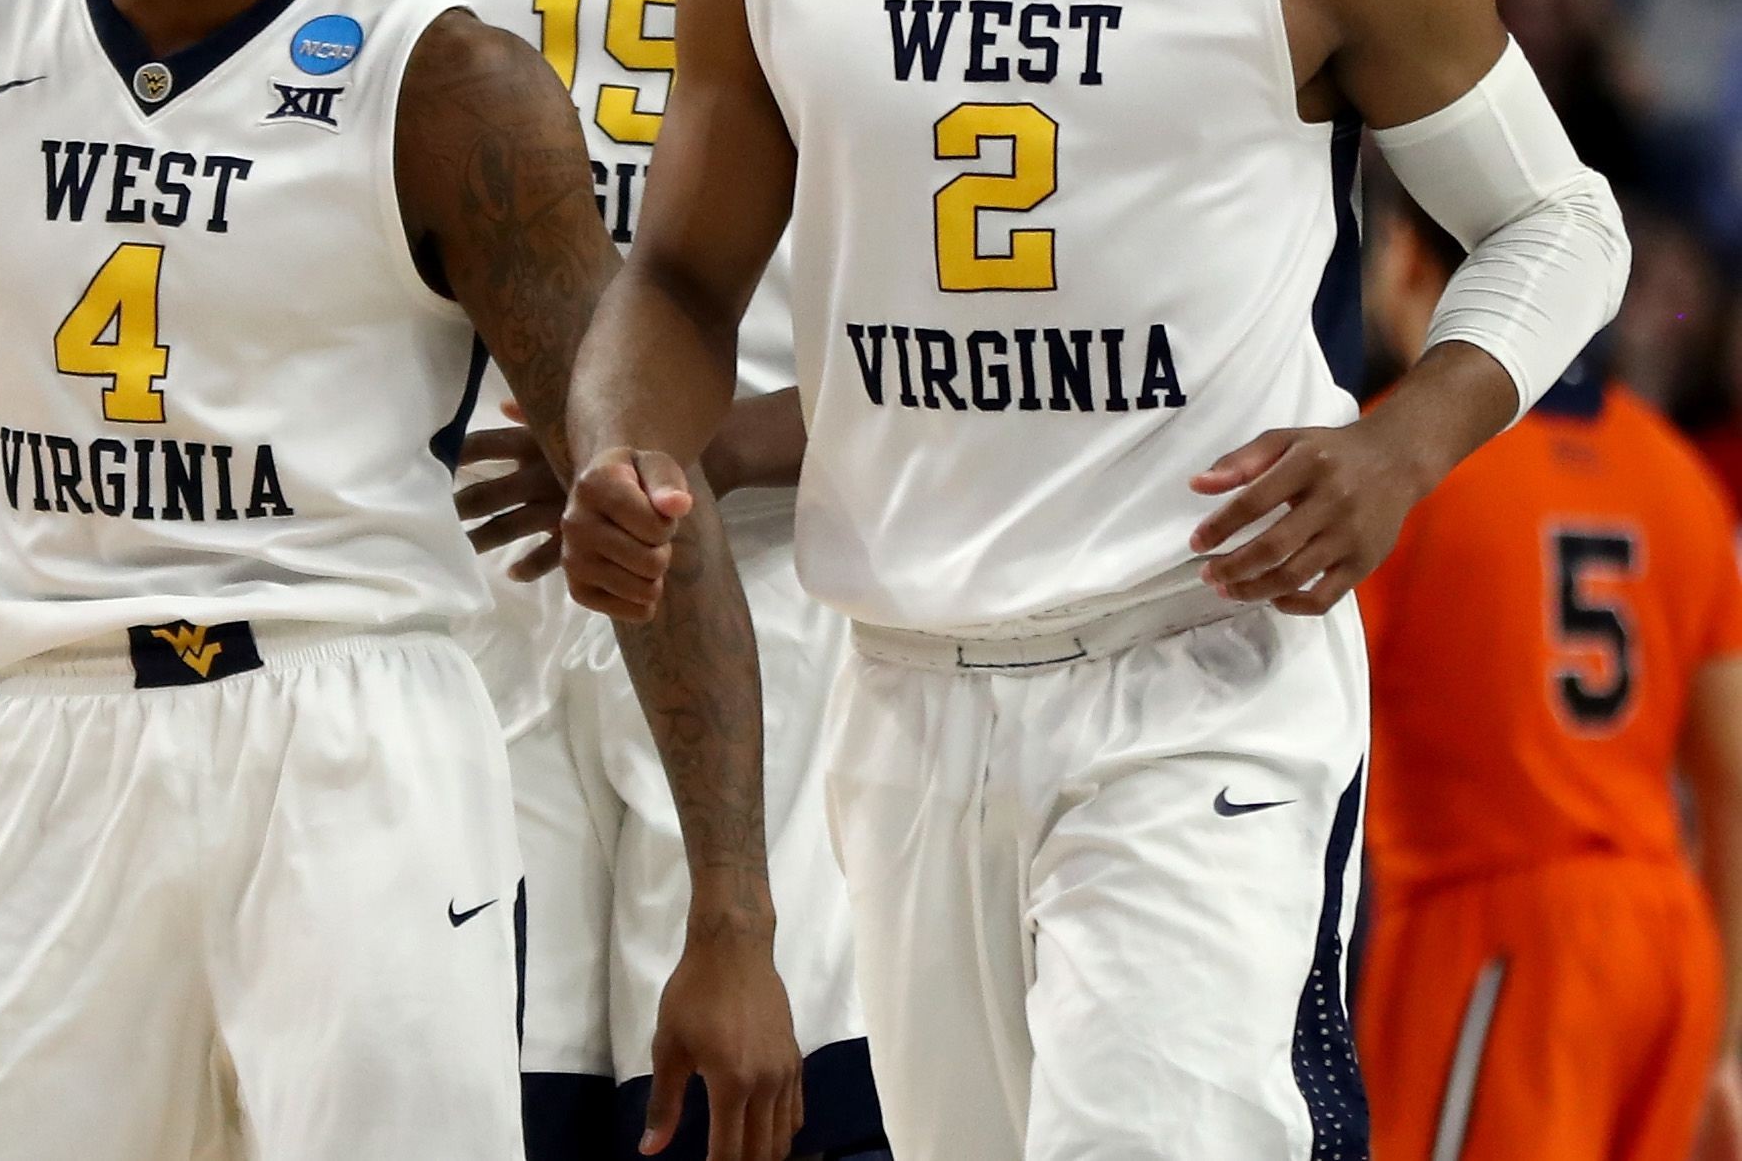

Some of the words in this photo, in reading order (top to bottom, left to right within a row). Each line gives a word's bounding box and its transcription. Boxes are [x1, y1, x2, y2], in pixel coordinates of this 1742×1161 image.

[41, 140, 253, 233] WEST
[932, 101, 1059, 293] 2
[54, 241, 170, 424] 4
[846, 323, 1187, 413] VIRGINIA
[0, 426, 295, 522] VIRGINIA
[1548, 526, 1642, 735] 5
